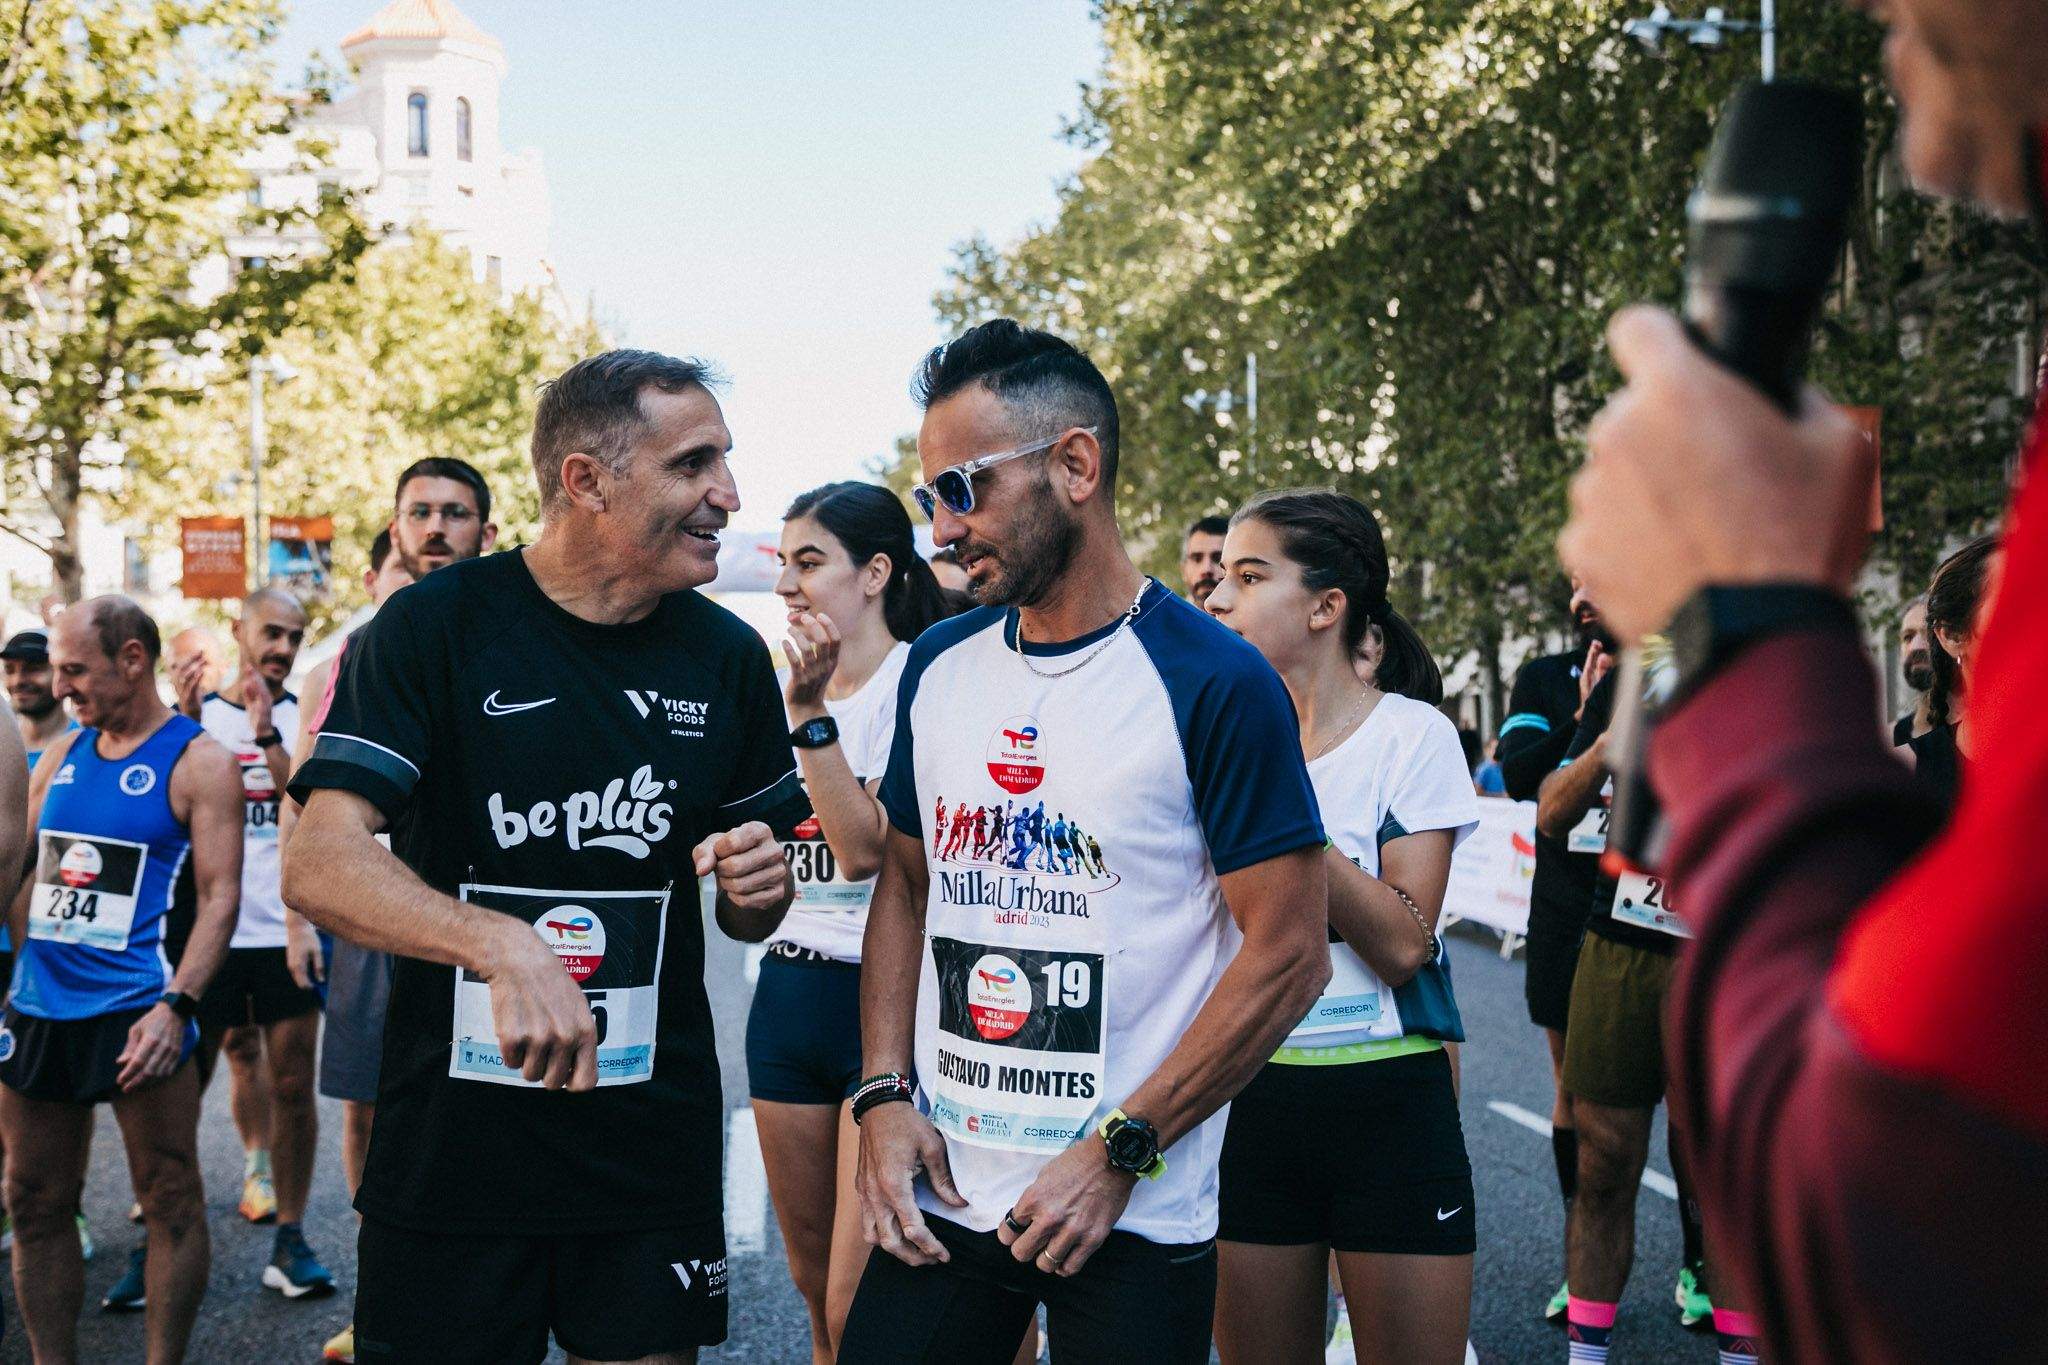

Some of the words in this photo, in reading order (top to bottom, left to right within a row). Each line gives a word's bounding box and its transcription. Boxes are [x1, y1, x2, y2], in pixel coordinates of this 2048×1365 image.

[662, 698, 708, 715] VICKY
[667, 712, 705, 725] FOODS
[671, 729, 704, 738] ATHLETICS
[243, 802, 279, 827] 04
[47, 888, 99, 923] 234
[994, 910, 1028, 926] adrid
[1029, 916, 1050, 928] 2023
[546, 943, 592, 952] otalEnergies
[561, 957, 581, 965] ILLA
[1041, 960, 1091, 1009] 19
[937, 1049, 991, 1089] GUSTAVO
[997, 1065, 1096, 1099] MONTES
[704, 1257, 727, 1276] VICK
